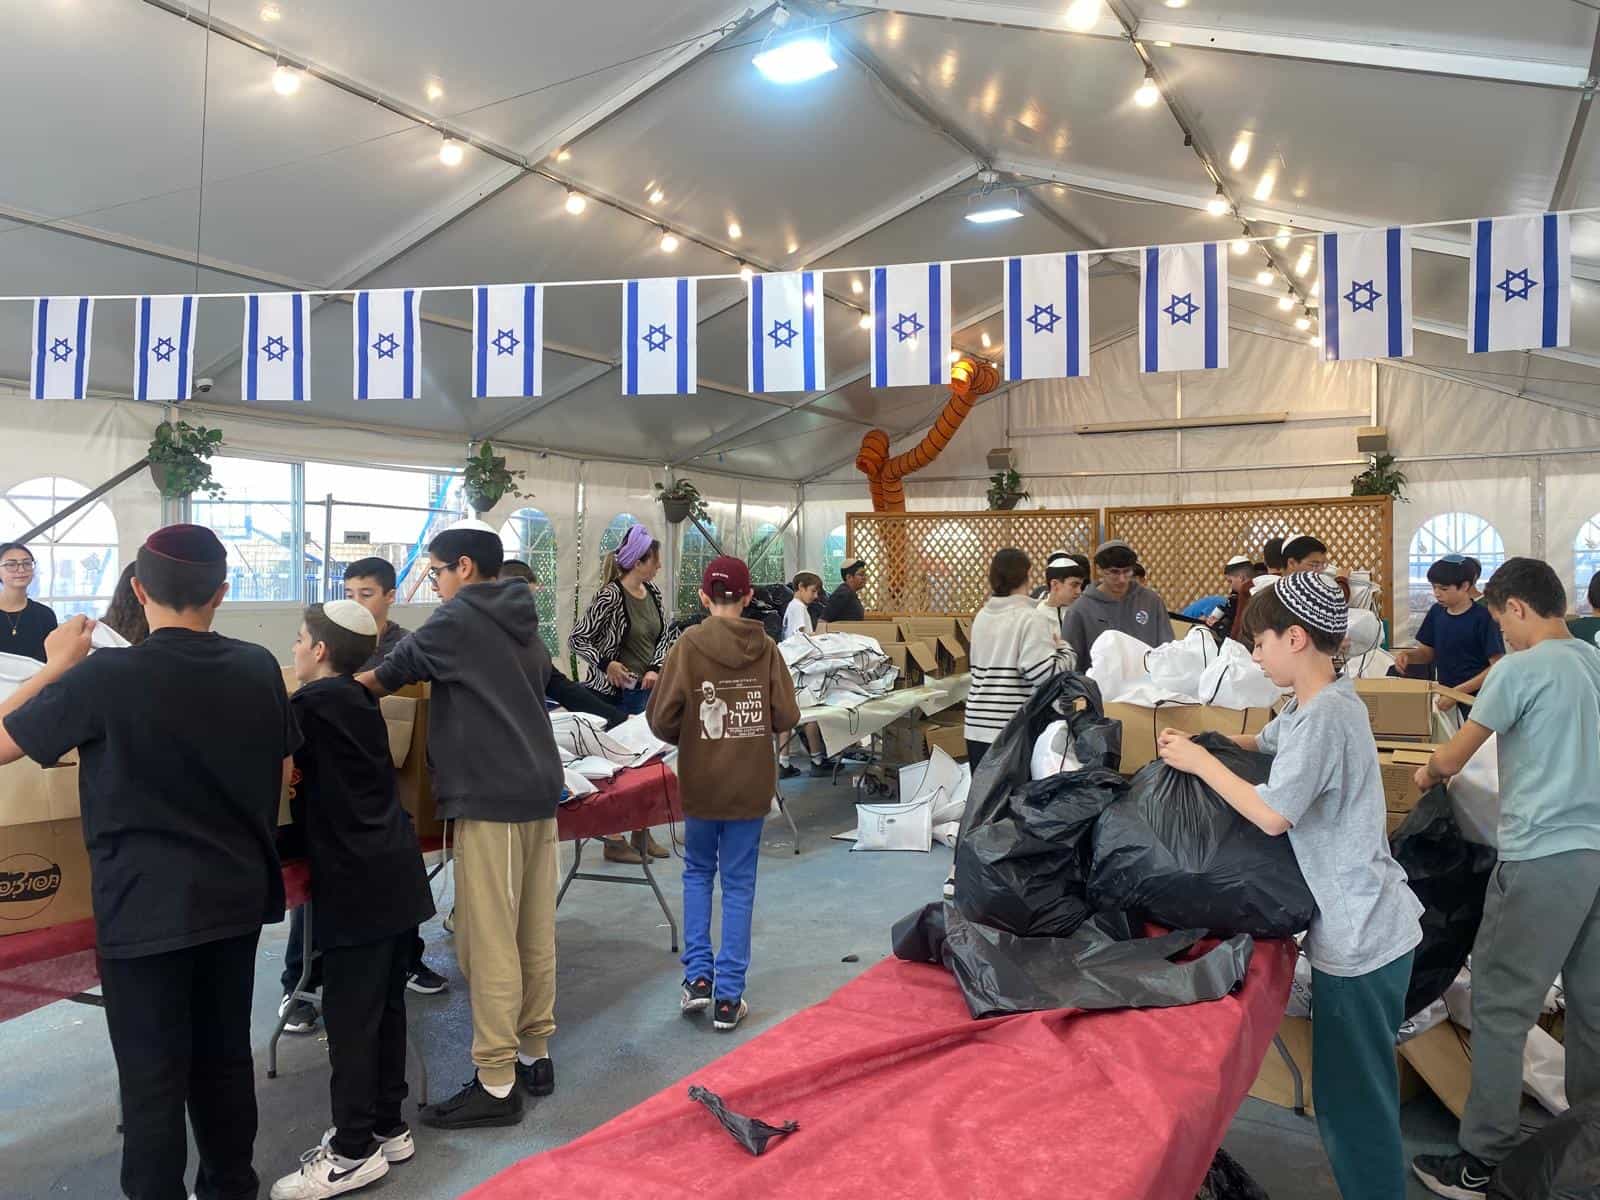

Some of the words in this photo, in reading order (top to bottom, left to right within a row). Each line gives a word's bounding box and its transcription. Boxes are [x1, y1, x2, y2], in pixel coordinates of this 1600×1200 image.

[747, 691, 761, 699] מה
[736, 699, 762, 710] הלמה
[729, 710, 762, 727] שלך?
